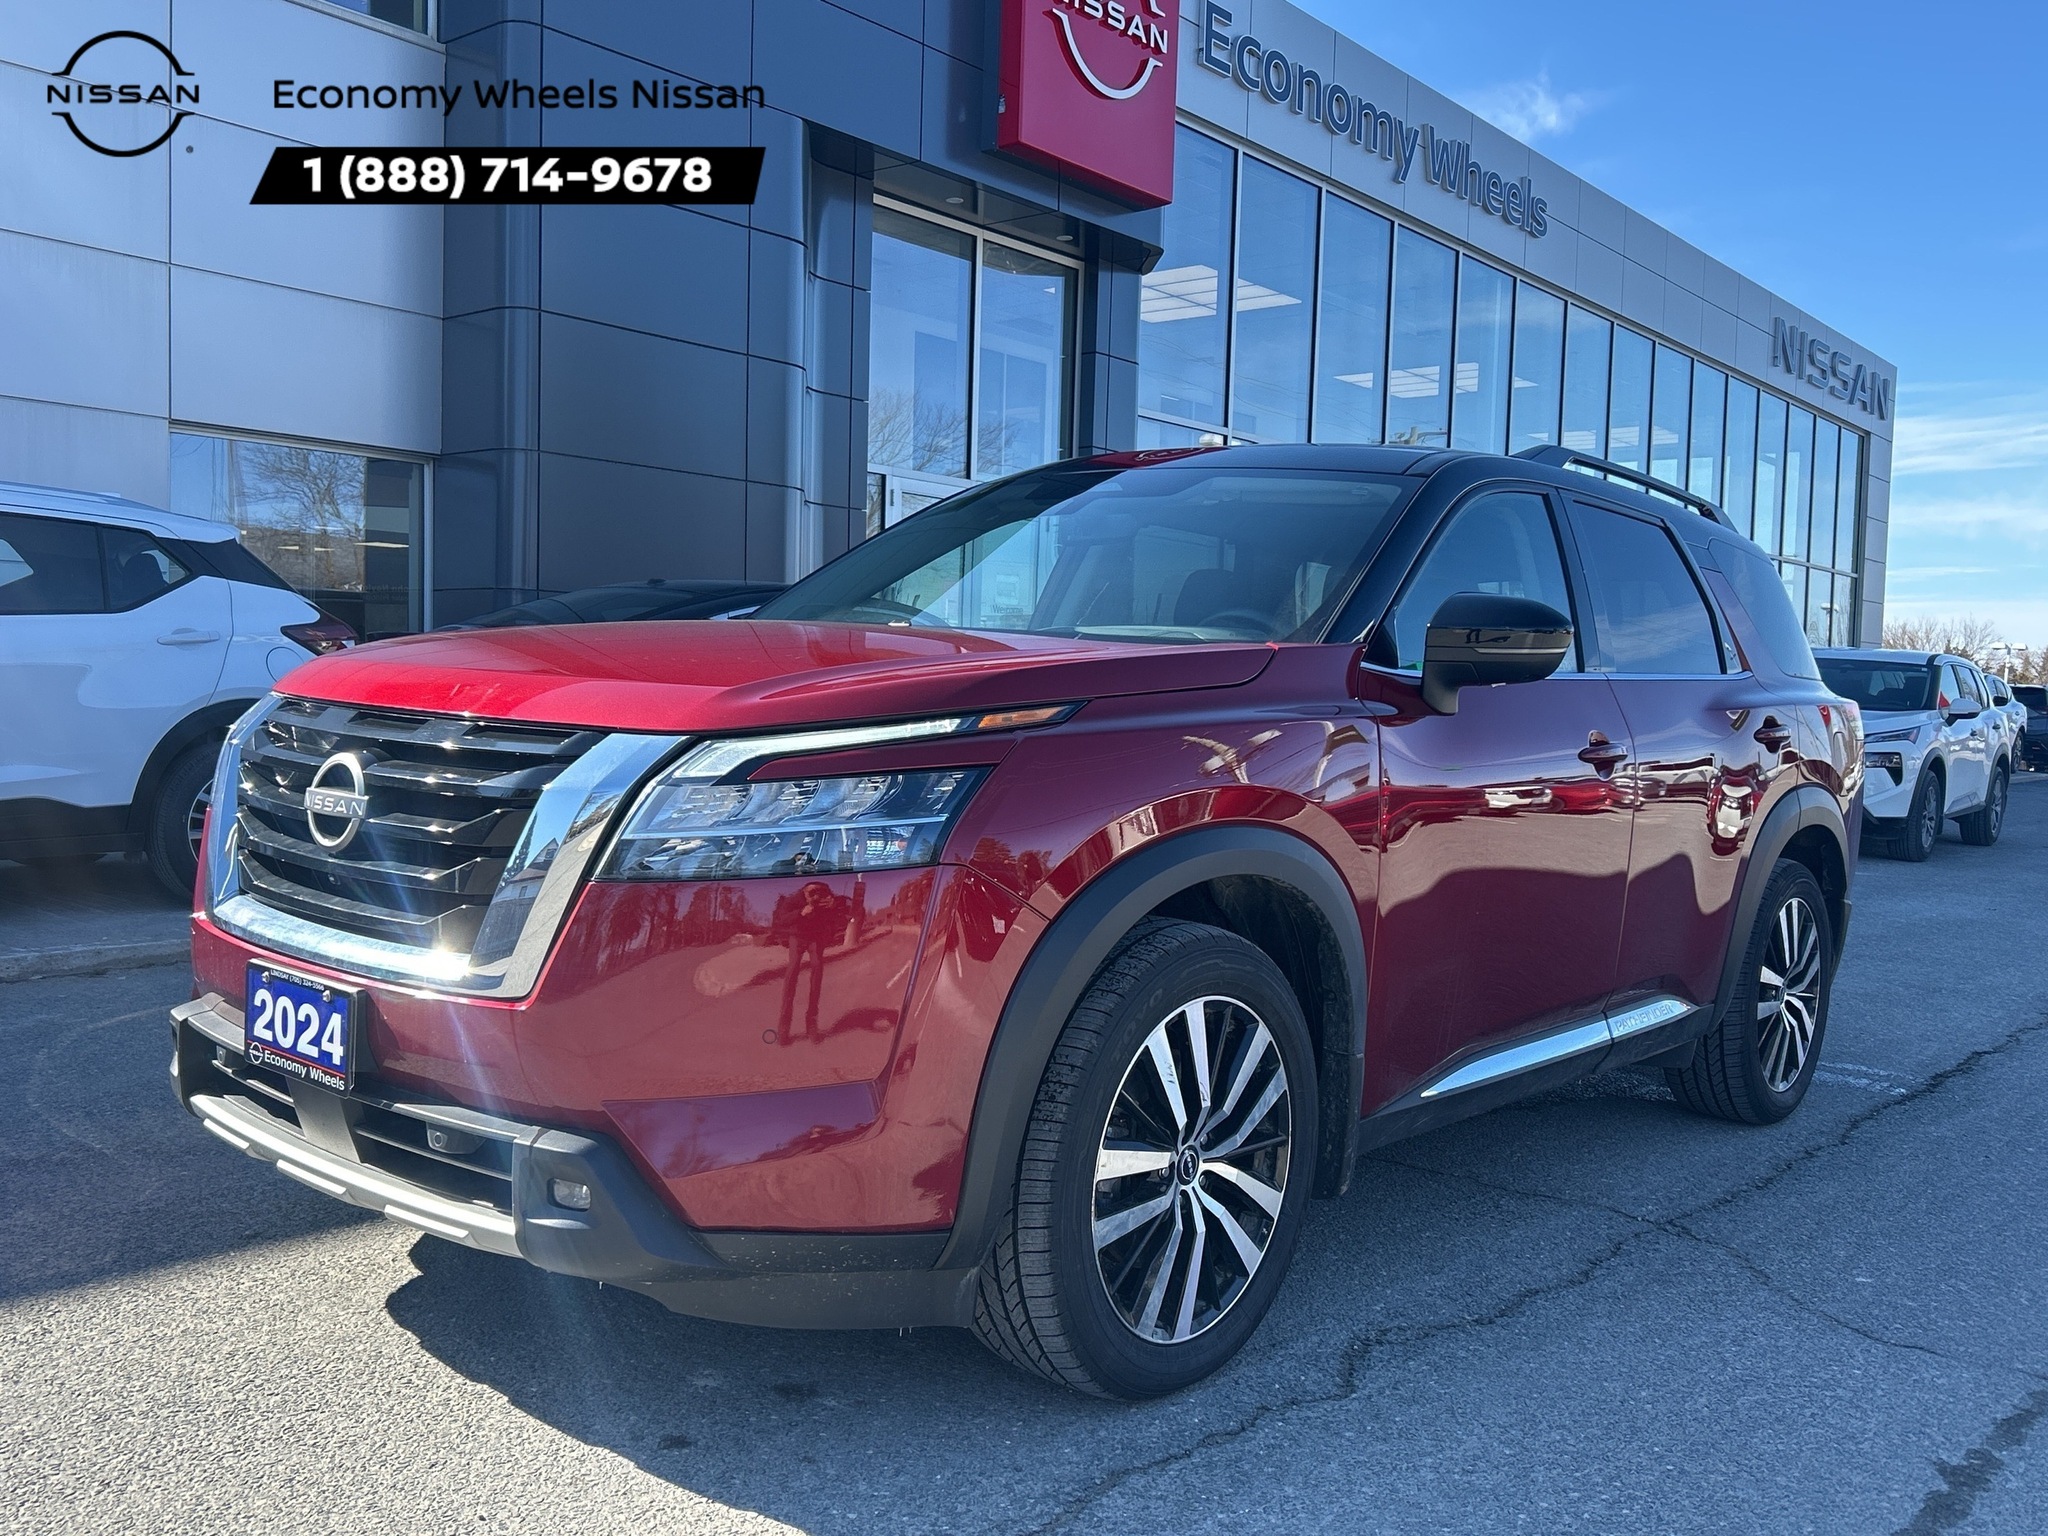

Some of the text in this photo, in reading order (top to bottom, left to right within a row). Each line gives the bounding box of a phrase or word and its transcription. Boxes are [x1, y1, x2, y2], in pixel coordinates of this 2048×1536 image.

[1063, 0, 1168, 54] SSAN
[1198, 0, 1548, 238] Economy Wheels
[1774, 317, 1890, 421] NISSAN
[306, 792, 364, 816] NISSAN
[254, 988, 344, 1066] 2024
[1613, 1003, 1675, 1032] PATHFINDER
[264, 1050, 345, 1091] Economy Wheels
